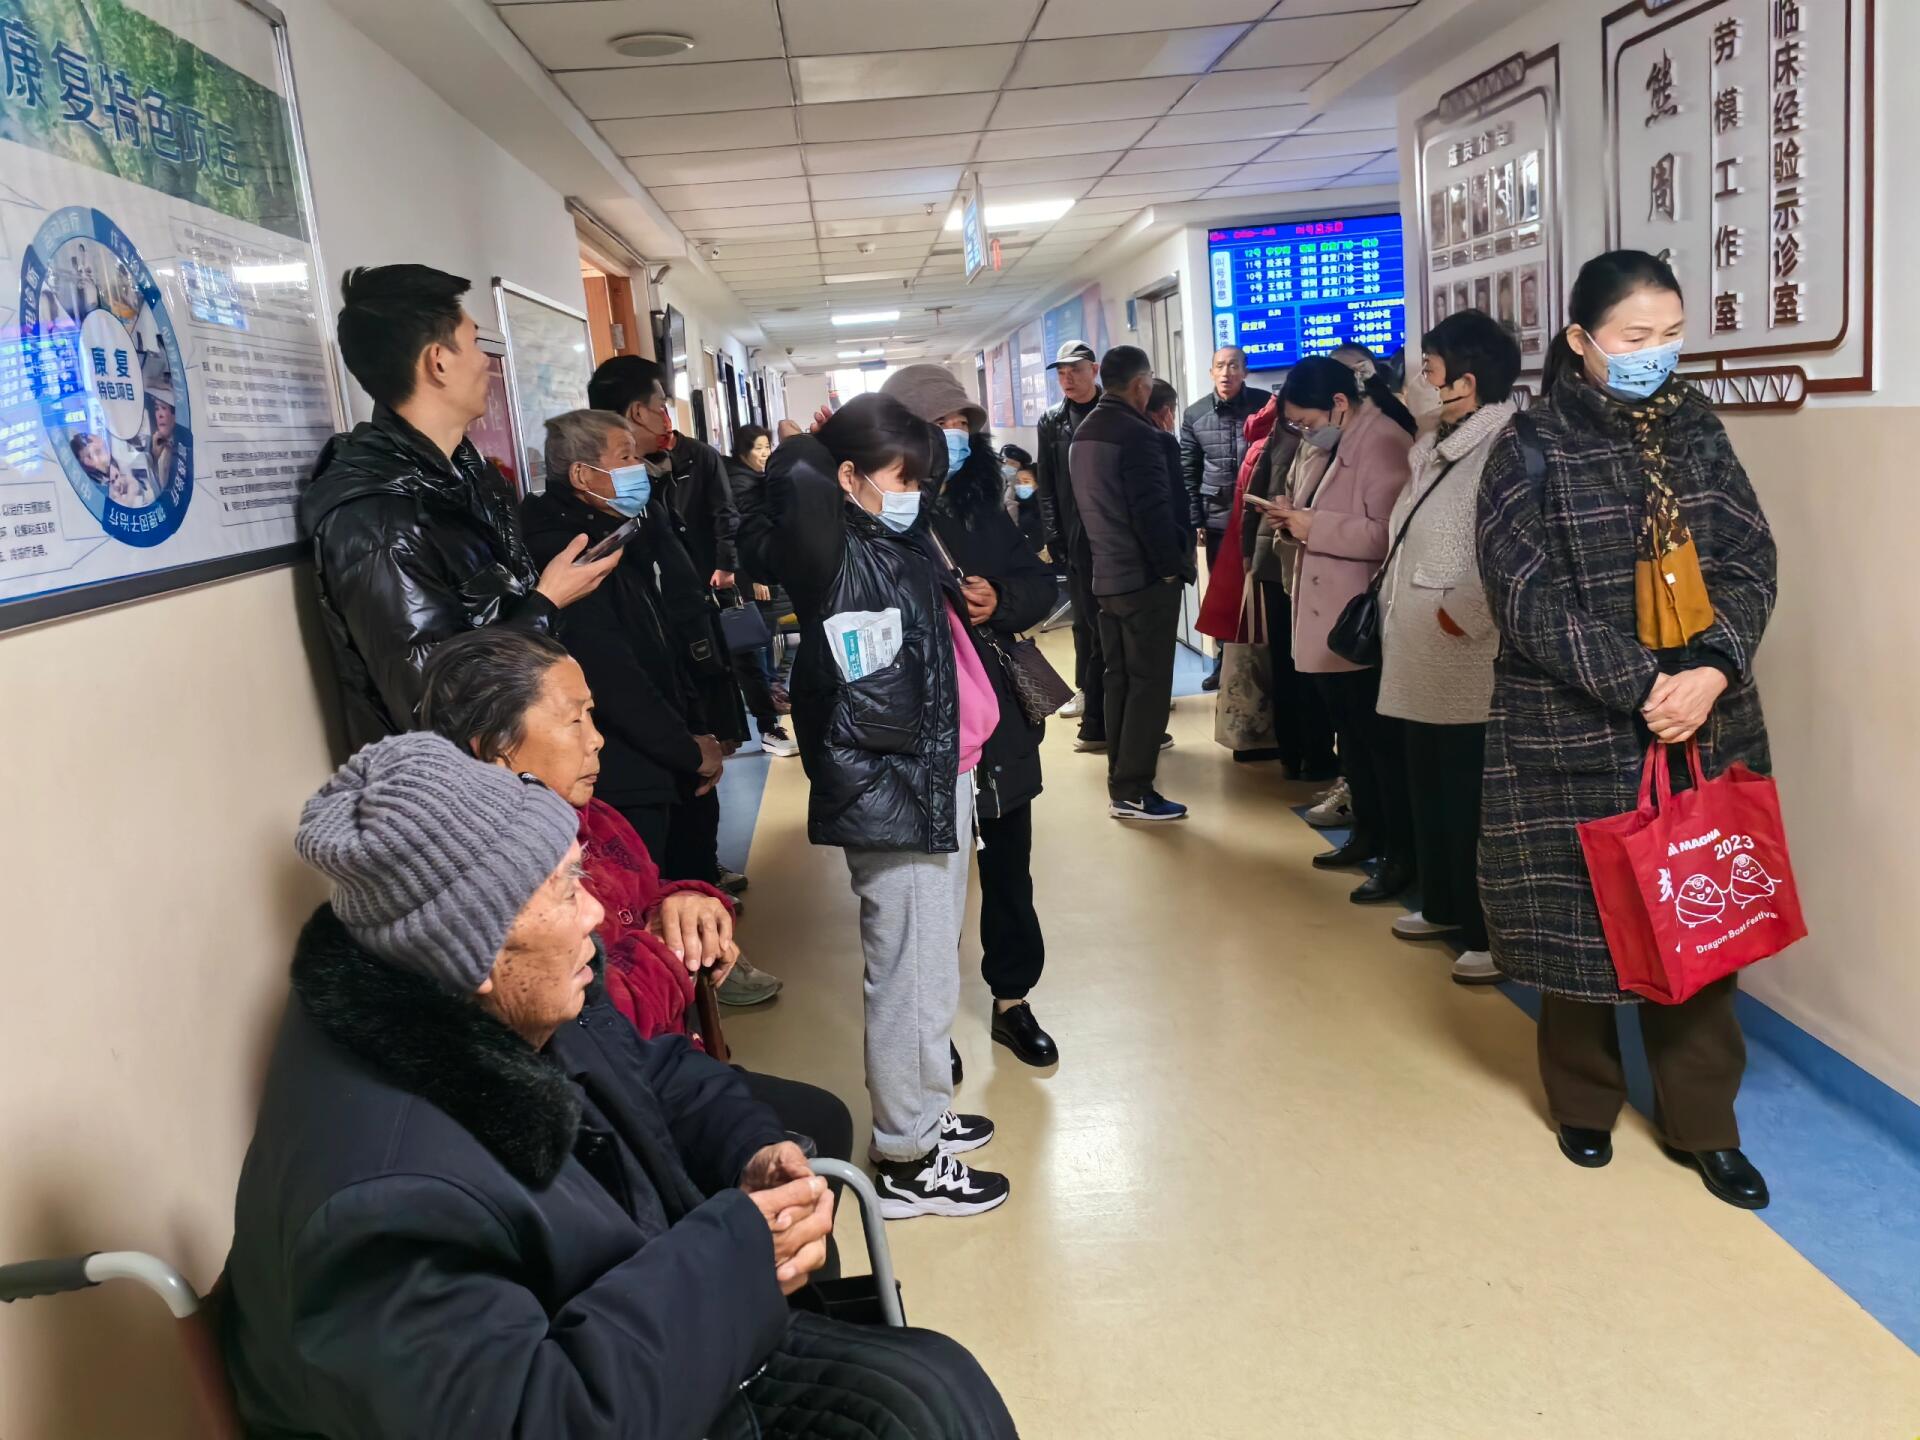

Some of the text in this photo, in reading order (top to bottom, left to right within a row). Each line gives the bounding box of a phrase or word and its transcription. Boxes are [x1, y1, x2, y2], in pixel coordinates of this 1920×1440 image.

[0, 16, 244, 189] 康复特色项目
[1714, 17, 1739, 331] 劳模工作室
[1774, 0, 1800, 324] 临床经验示诊室
[91, 346, 131, 378] 康复
[97, 380, 135, 401] 特色项目
[108, 503, 167, 533] 物理因子治疗
[1680, 828, 1721, 852] MAGNA
[1714, 835, 1755, 860] 2023
[1696, 935, 1728, 954] Dragon
[1728, 924, 1746, 938] Boat
